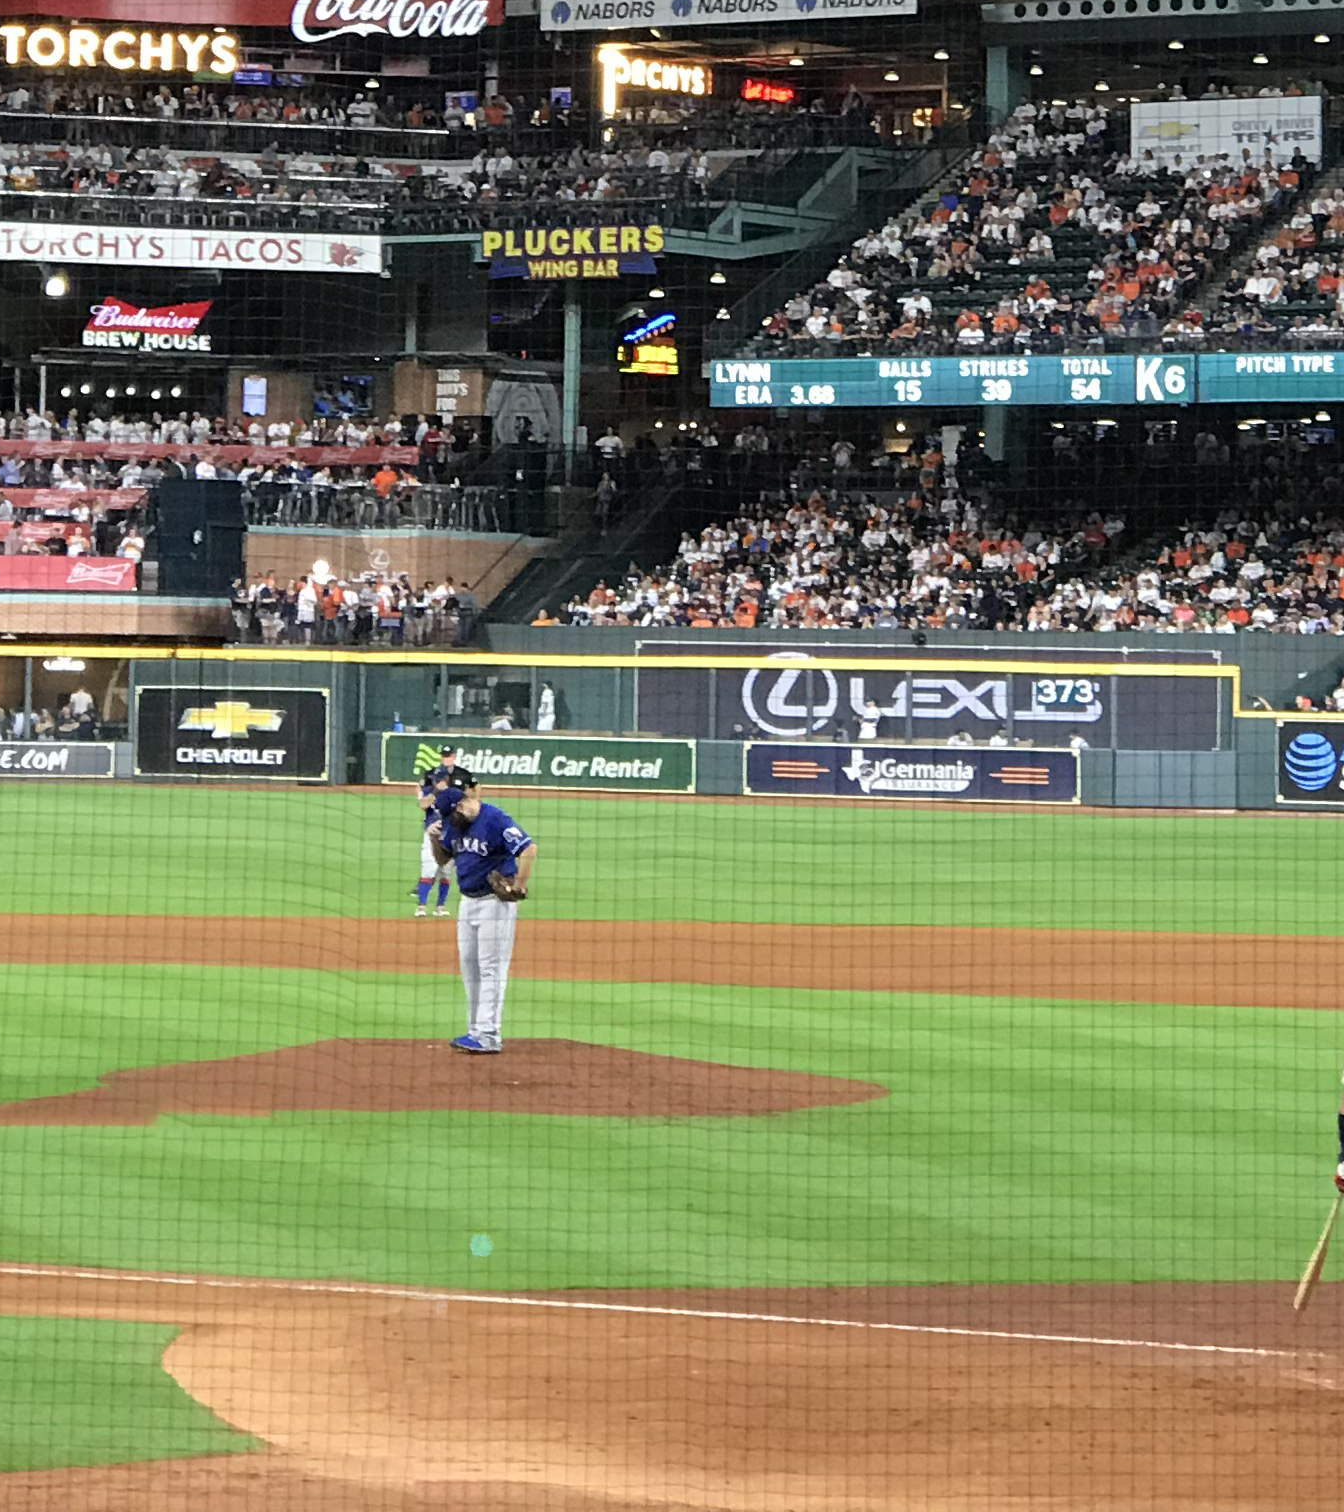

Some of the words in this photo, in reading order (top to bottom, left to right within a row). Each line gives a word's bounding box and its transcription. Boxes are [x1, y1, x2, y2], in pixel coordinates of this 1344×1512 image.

[575, 0, 656, 22] NABORS
[2, 228, 165, 259] TORCHYS
[192, 236, 304, 265] TACOS
[482, 225, 664, 259] PLUCKERS
[527, 261, 577, 279] WING
[582, 258, 619, 278] BAR
[90, 304, 200, 330] Budweiser
[82, 331, 141, 348] BREW
[143, 333, 212, 351] HOUSE
[715, 363, 771, 383] LYNN
[878, 360, 932, 378] BALLS
[959, 358, 1029, 377] STRIKES
[1062, 358, 1112, 376] TOTAL
[1235, 354, 1286, 374] PITCH
[1291, 354, 1335, 373] TYPE
[1070, 379, 1101, 400] 54
[1136, 357, 1163, 401] K
[1164, 365, 1186, 394] 6
[735, 385, 773, 405] ERA
[893, 381, 922, 402] 15
[1037, 678, 1094, 703] 373
[176, 747, 286, 766] CHEVROLET
[551, 756, 588, 777] Car
[590, 757, 663, 779] Rental
[880, 758, 975, 780] Germania
